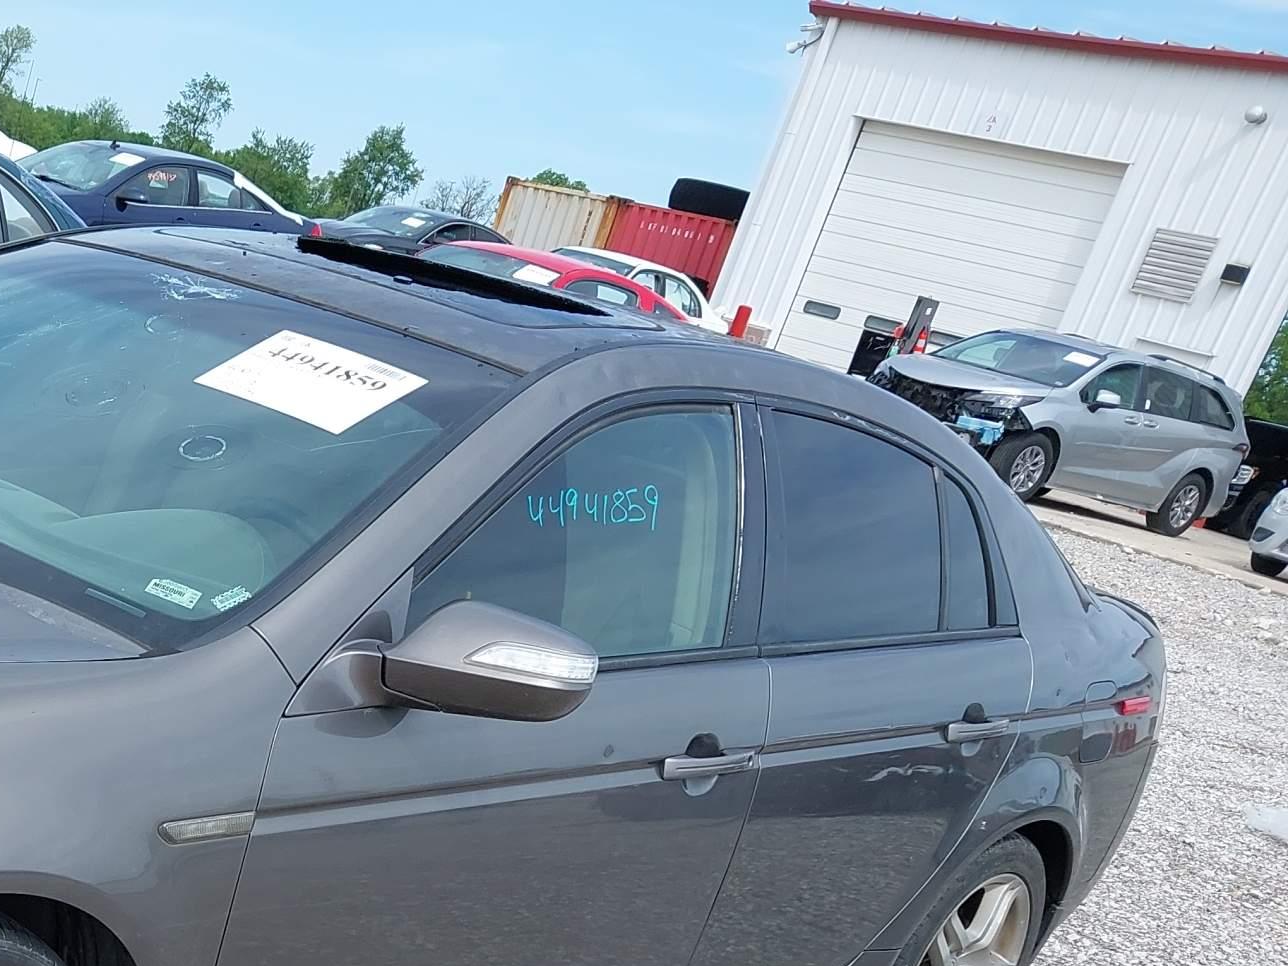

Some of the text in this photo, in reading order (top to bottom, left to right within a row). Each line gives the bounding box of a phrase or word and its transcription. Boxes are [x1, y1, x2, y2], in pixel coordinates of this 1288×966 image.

[268, 347, 387, 391] 44941859
[527, 485, 659, 531] 44941859
[152, 581, 186, 598] MISSOURI
